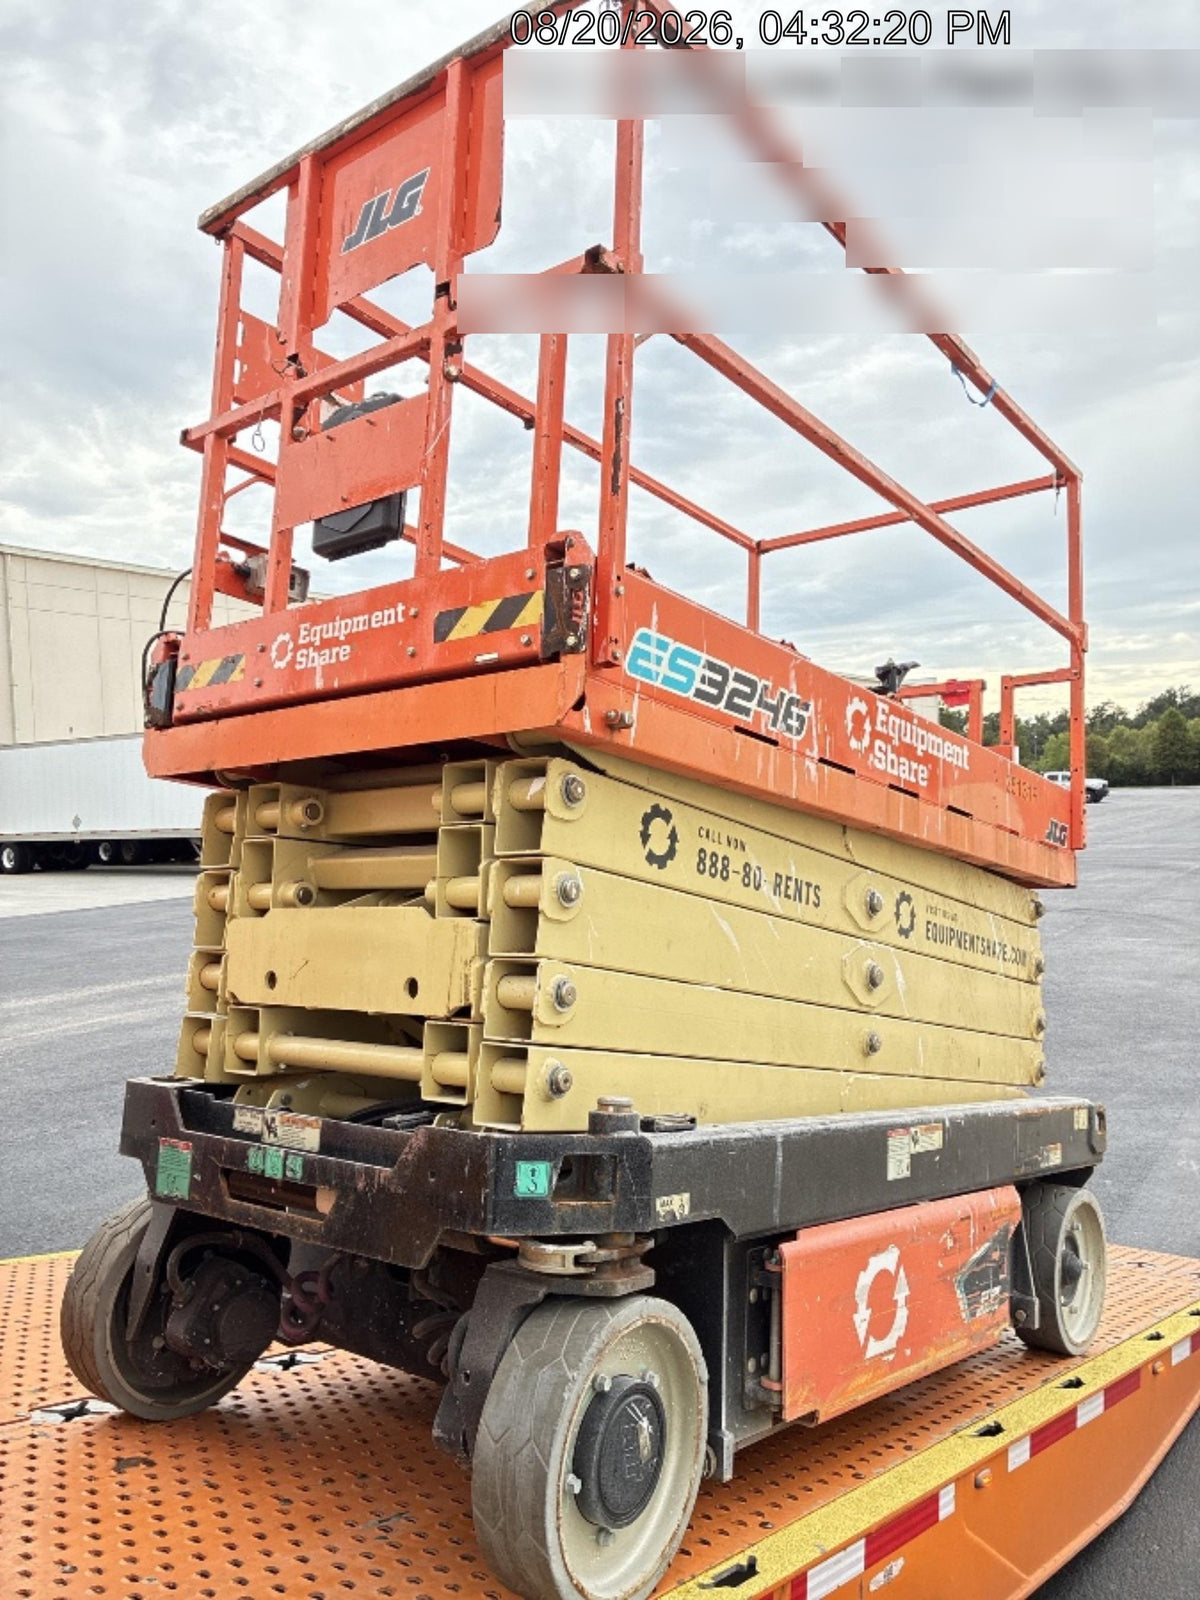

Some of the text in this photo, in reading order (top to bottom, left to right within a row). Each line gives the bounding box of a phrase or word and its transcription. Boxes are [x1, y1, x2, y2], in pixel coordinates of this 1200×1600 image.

[341, 168, 429, 254] JLG
[298, 602, 405, 645] Equipment
[295, 644, 351, 670] Share
[626, 630, 812, 738] ES3246
[875, 700, 970, 770] Equipment
[874, 739, 928, 787] Share
[698, 826, 722, 845] CALL
[1046, 819, 1068, 848] JLG
